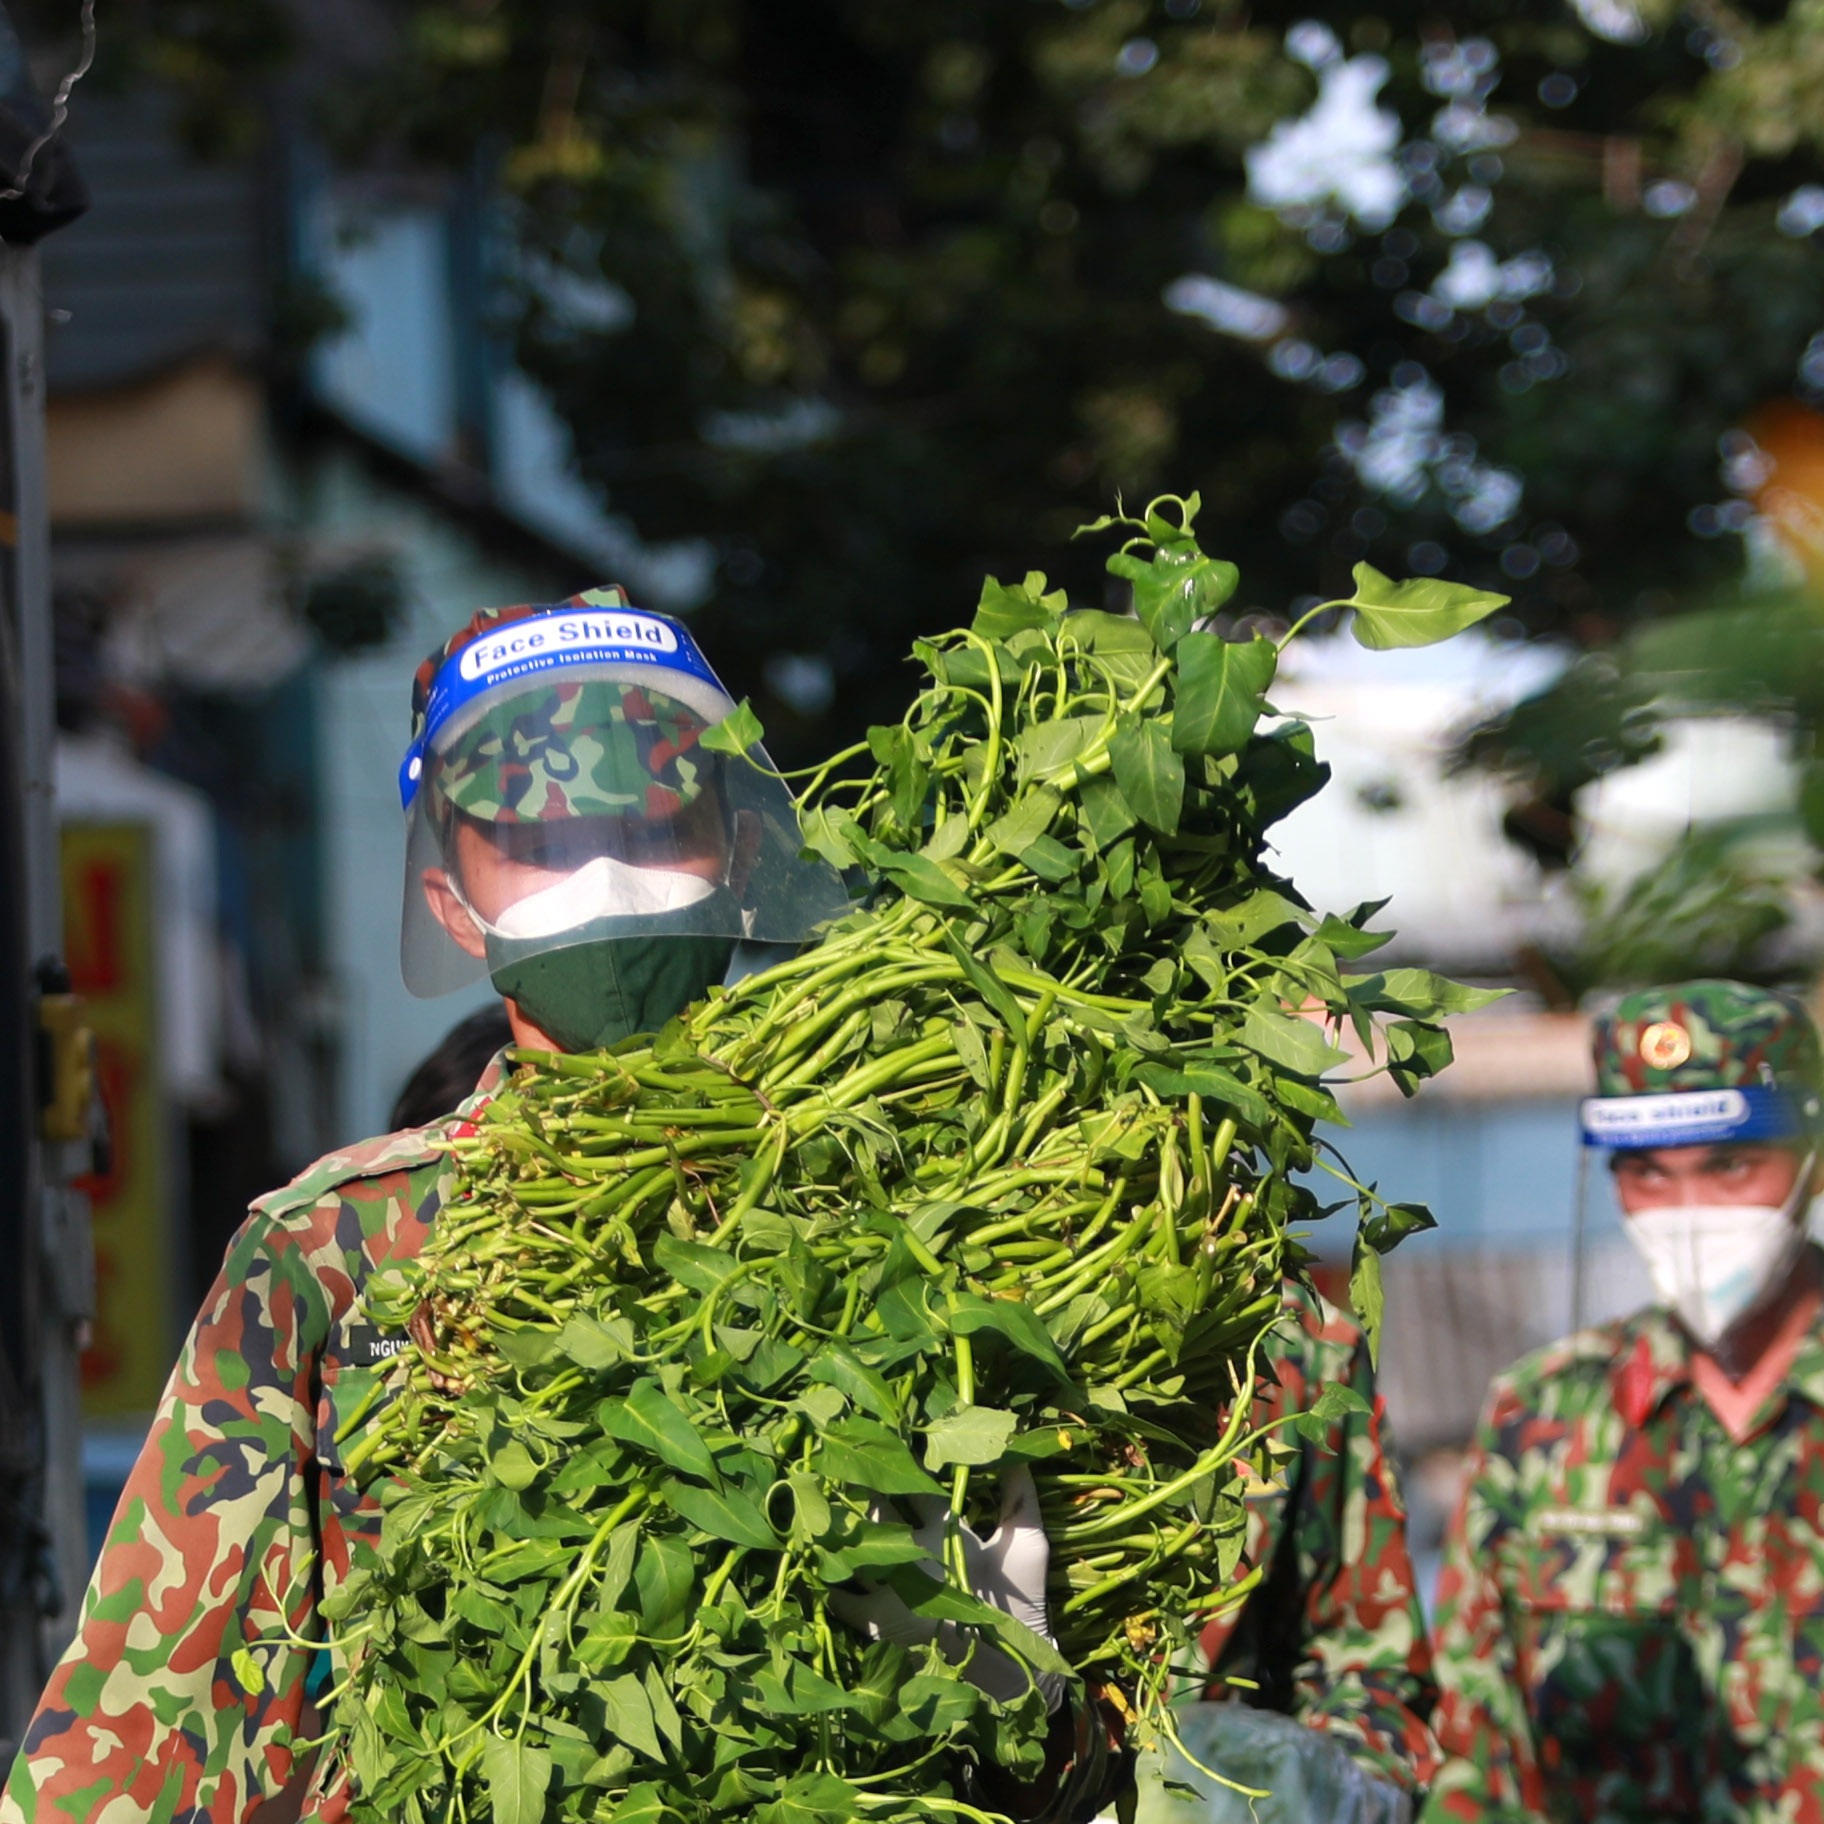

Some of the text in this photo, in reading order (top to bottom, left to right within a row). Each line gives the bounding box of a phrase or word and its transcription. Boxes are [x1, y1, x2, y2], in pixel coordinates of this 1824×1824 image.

[474, 620, 663, 668] Face Shield
[486, 649, 657, 685] Protective Isolation Mask
[369, 1340, 410, 1357] NGUY
